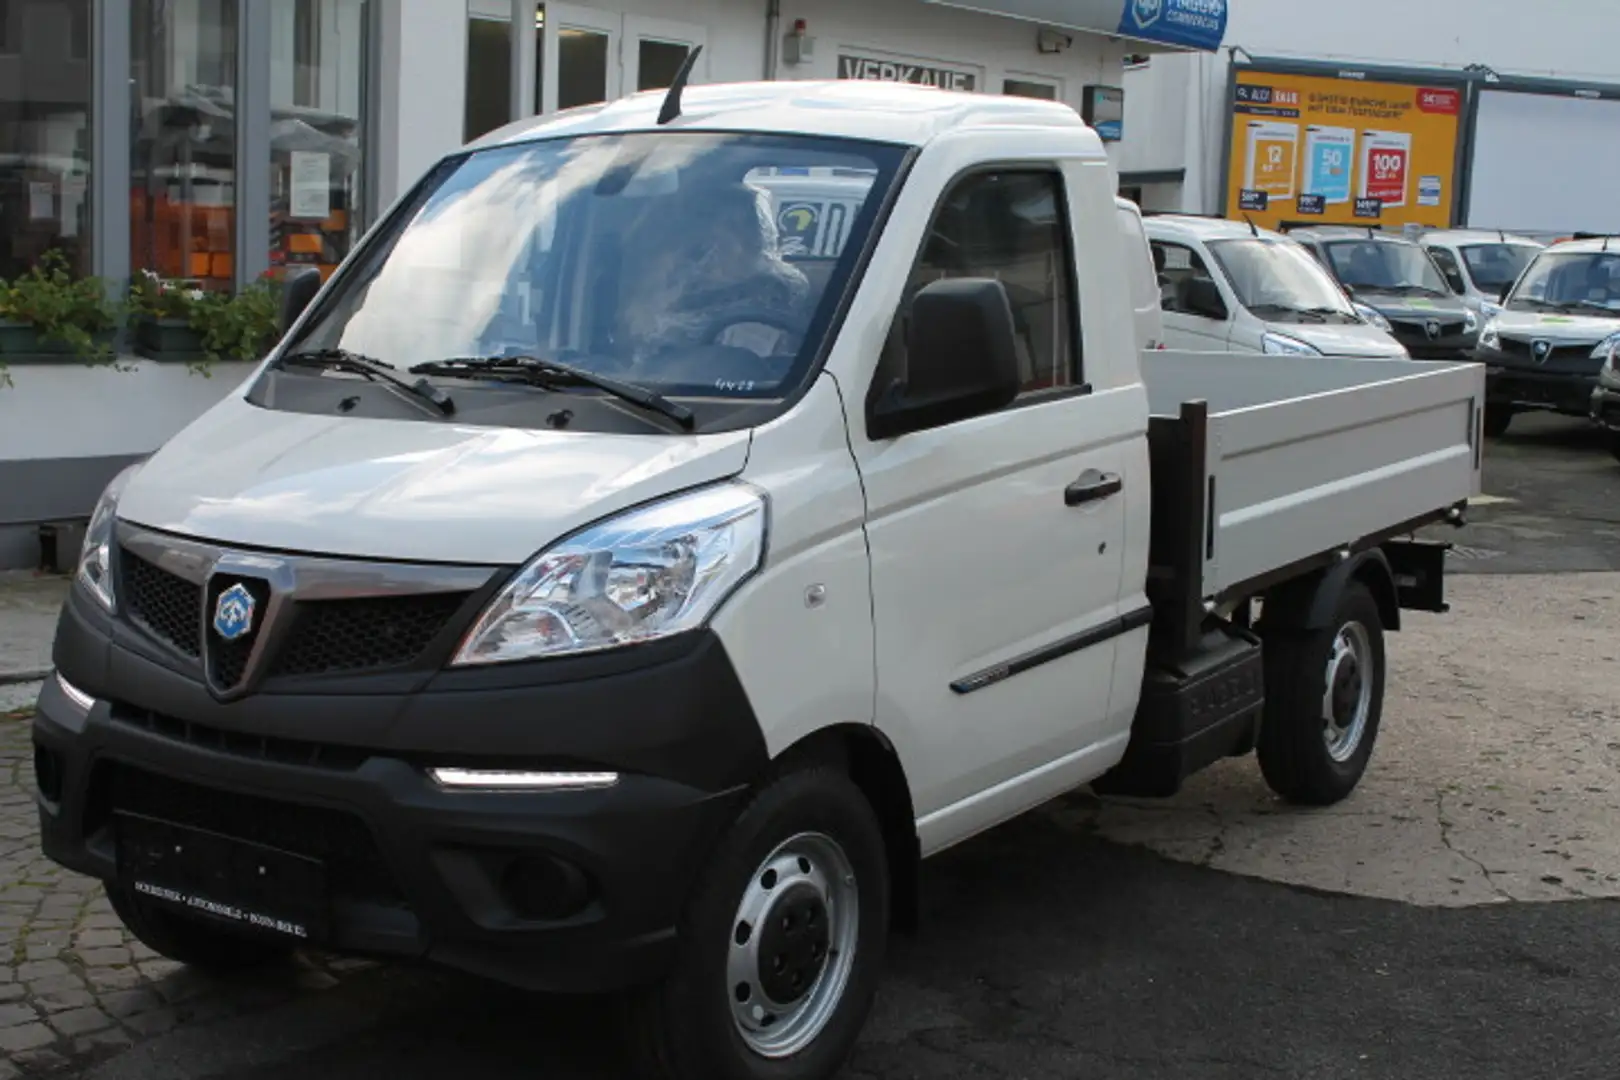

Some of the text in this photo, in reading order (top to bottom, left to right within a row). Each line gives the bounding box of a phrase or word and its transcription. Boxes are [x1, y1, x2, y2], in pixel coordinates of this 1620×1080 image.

[845, 59, 966, 90] VERKAUF
[1322, 148, 1342, 166] 50
[1372, 153, 1401, 172] 100
